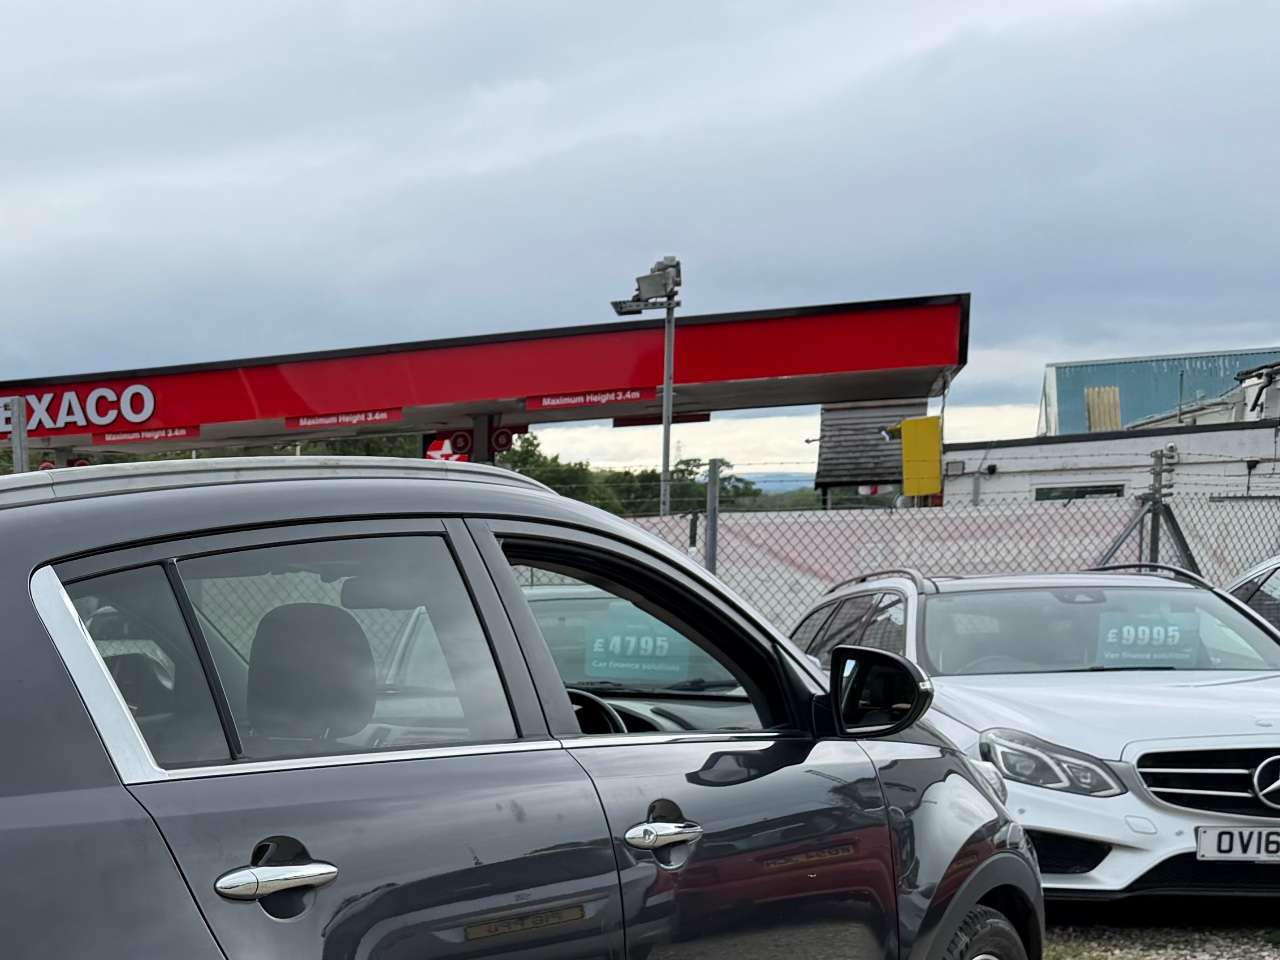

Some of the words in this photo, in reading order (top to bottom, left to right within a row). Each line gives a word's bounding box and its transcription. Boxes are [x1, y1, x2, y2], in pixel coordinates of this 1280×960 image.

[542, 397, 584, 406] Maximum
[586, 393, 615, 404] Height
[616, 391, 640, 401] 3.4m
[299, 416, 337, 426] Maximum
[339, 412, 365, 424] Height
[105, 432, 140, 441] Maximum
[141, 430, 166, 440] Height
[1217, 830, 1280, 854] OV16
